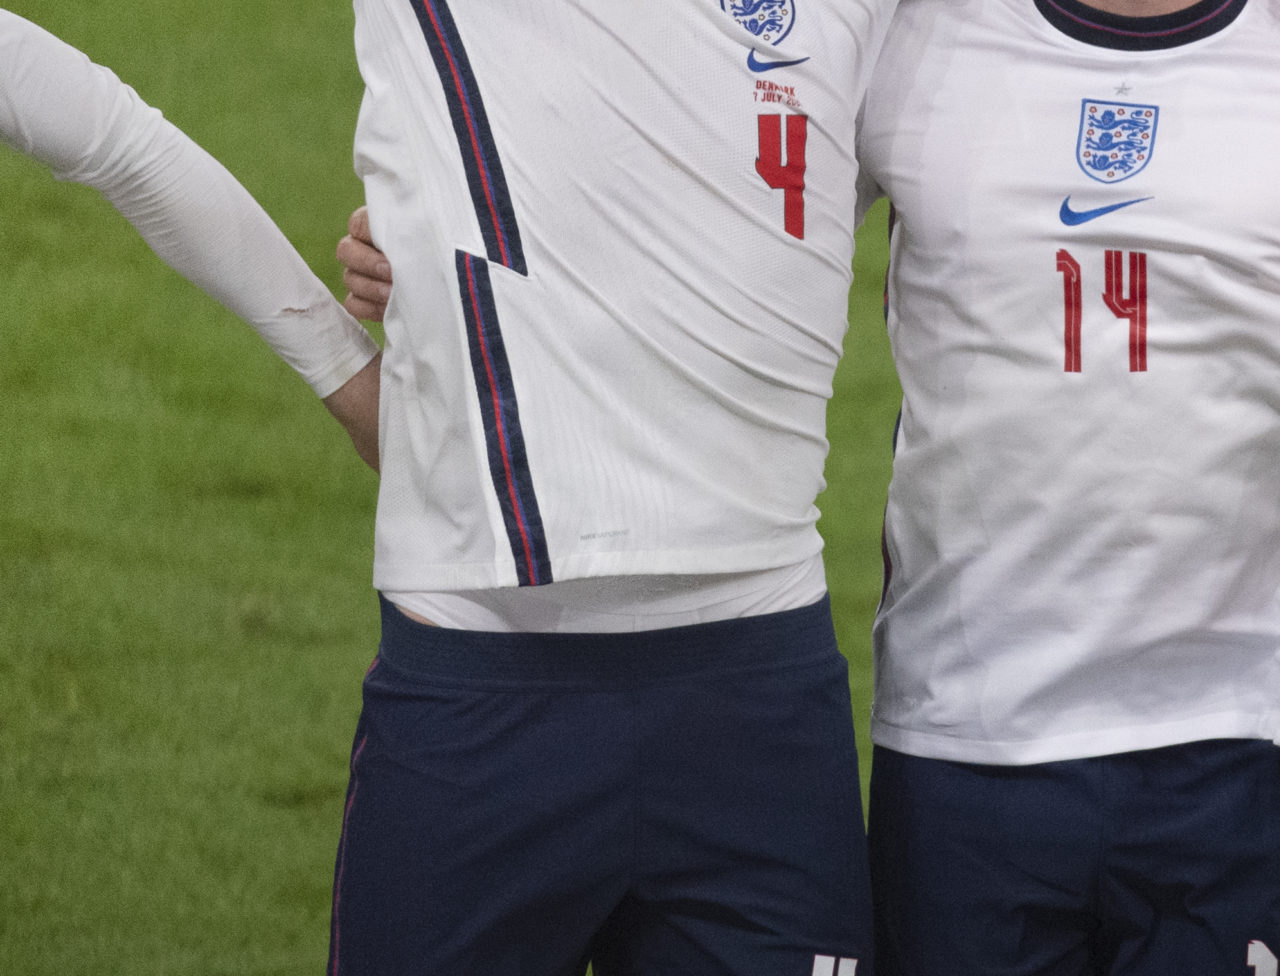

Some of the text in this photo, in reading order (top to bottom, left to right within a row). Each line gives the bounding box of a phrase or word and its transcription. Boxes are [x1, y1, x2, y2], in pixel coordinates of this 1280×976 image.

[761, 92, 783, 103] JULY
[755, 114, 809, 240] 4
[1056, 248, 1148, 373] 14
